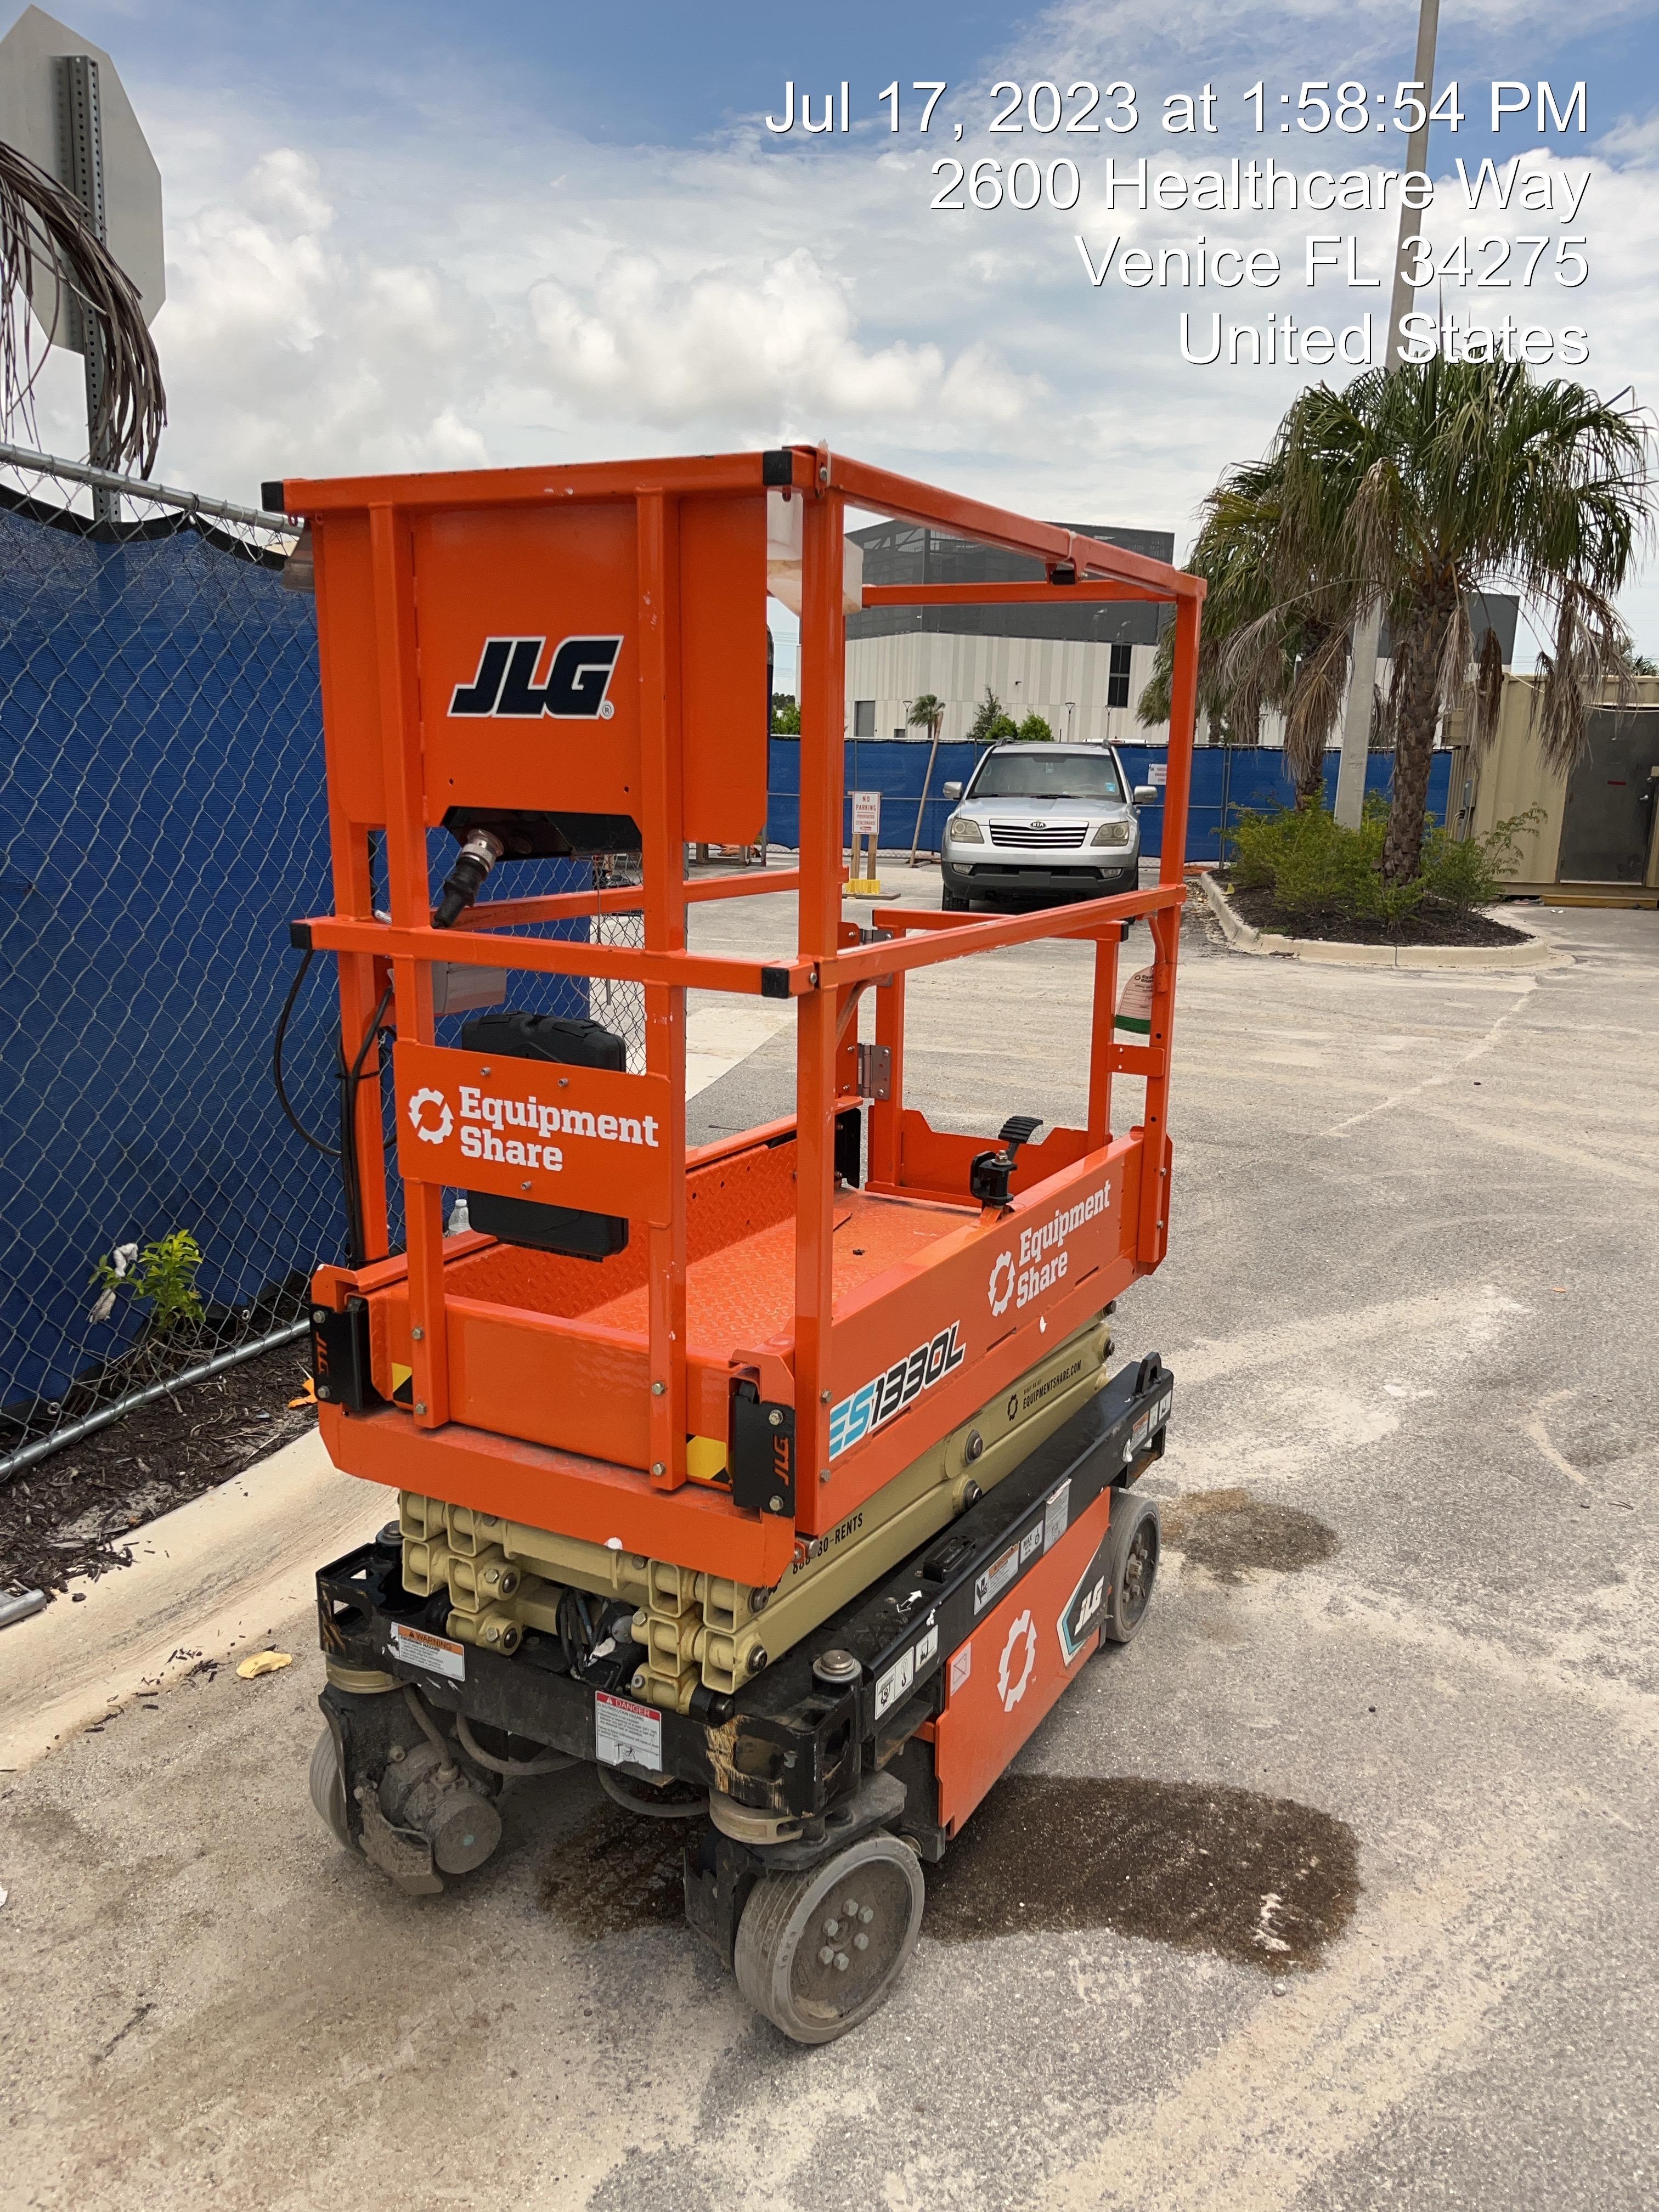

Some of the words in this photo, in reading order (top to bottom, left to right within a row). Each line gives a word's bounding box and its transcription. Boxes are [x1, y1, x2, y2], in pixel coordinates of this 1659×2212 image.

[447, 635, 624, 720] JLG
[459, 1086, 659, 1147] Equipment
[460, 1125, 563, 1172] Share
[1019, 1180, 1111, 1267] Equipment
[1016, 1251, 1068, 1309] Share
[316, 1331, 329, 1377] JLG
[830, 1320, 966, 1461] ES1330L
[1023, 1359, 1081, 1409] EQUIPMENTSHARE.COM
[773, 1434, 789, 1486] JLG
[1074, 1575, 1104, 1636] JLG
[416, 1633, 452, 1650] WARNING
[616, 1699, 650, 1717] DANGER
